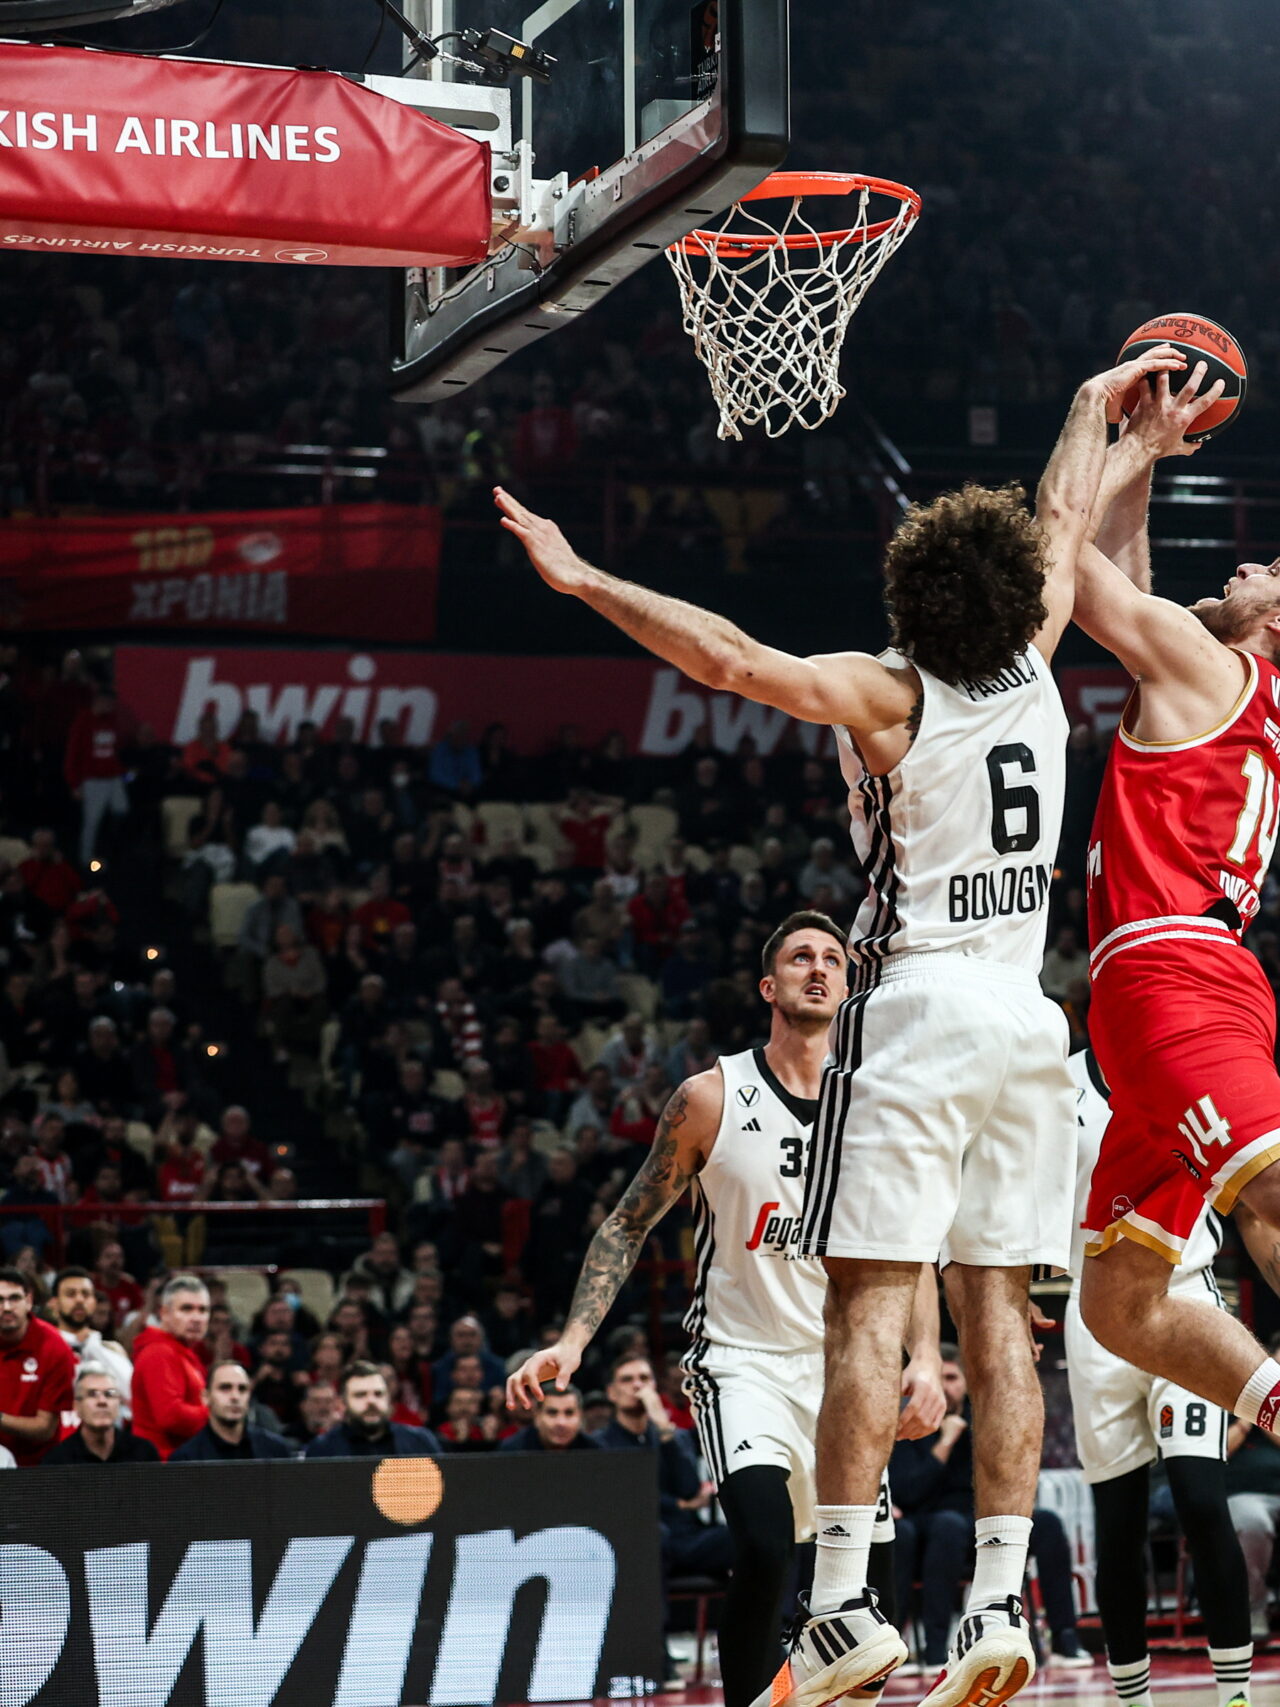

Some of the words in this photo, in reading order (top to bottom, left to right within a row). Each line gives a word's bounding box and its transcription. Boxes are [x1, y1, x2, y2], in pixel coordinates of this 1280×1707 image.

[115, 116, 341, 163] AIRLINES
[2, 234, 132, 250] AIRLINES
[139, 242, 261, 258] TURKISH
[1140, 318, 1232, 353] SPALDING
[172, 654, 438, 748] bwin
[986, 742, 1041, 856] 6
[1177, 1094, 1232, 1167] 14
[780, 1137, 812, 1178] 3
[1185, 1403, 1207, 1436] 8
